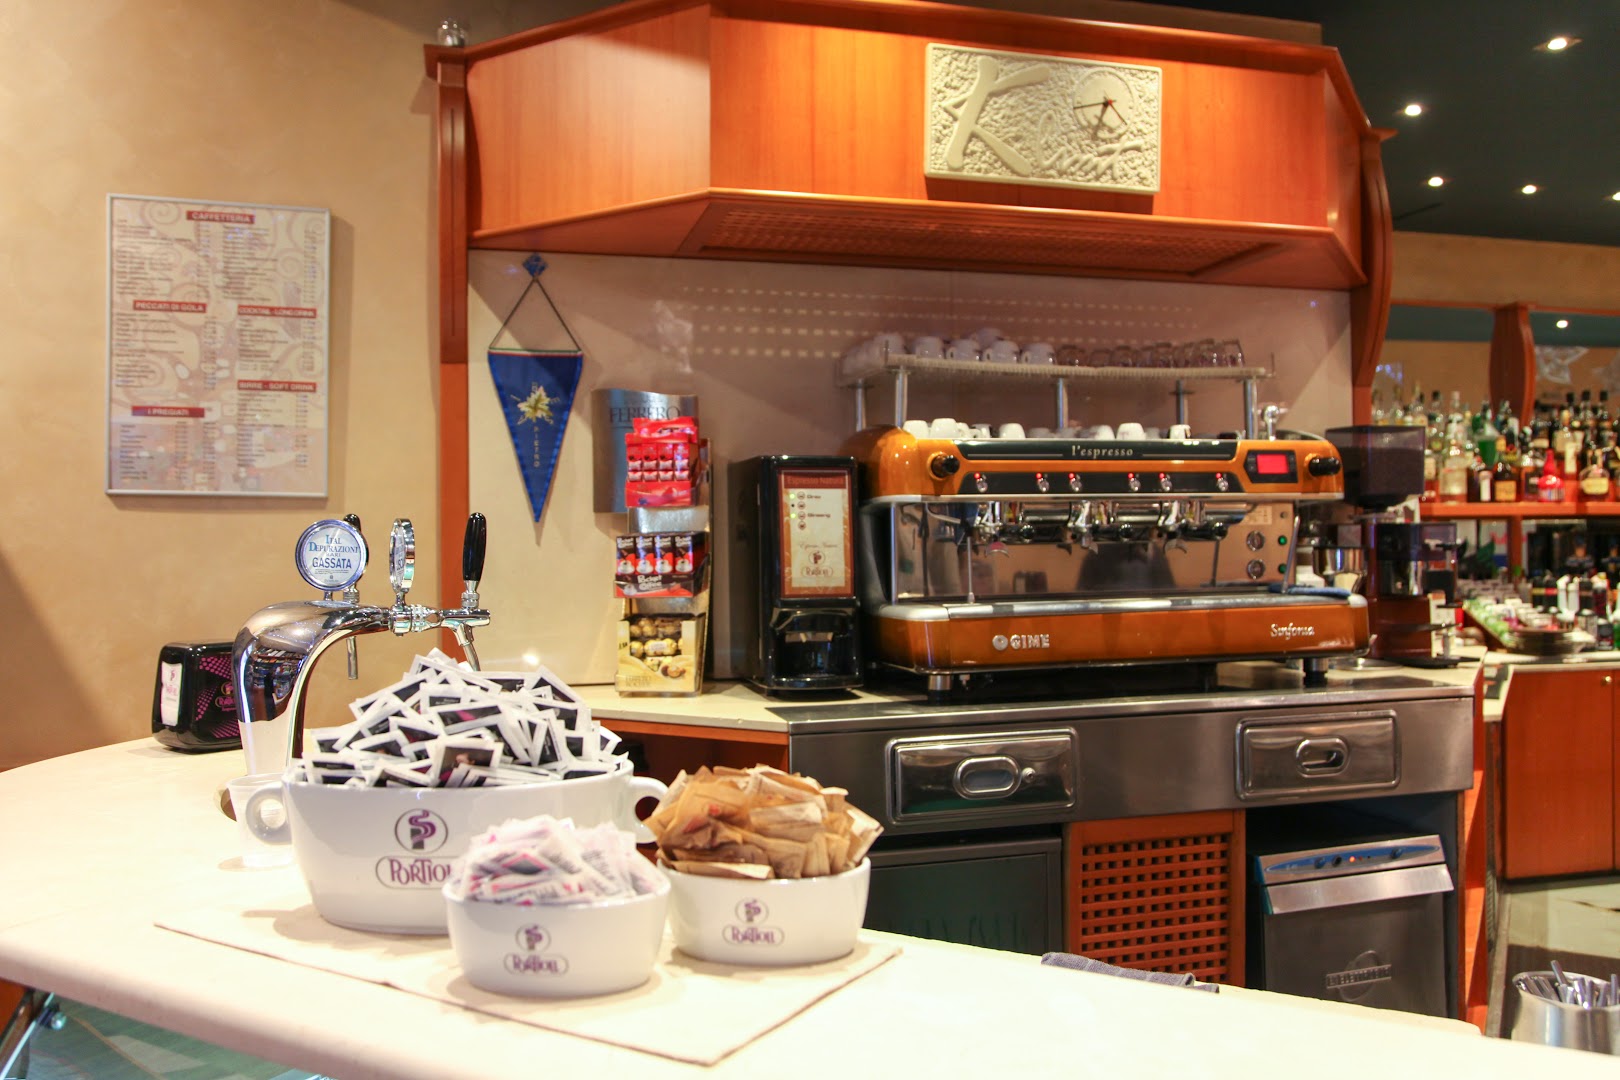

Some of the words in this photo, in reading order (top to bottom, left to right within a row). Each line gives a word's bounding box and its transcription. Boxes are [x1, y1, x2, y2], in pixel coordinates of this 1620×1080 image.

[191, 211, 251, 223] CAFFETTERIA
[135, 301, 170, 311] PECCATI
[180, 303, 204, 312] GOLA
[269, 382, 289, 391] SOFT
[1071, 445, 1134, 460] l'espresso
[312, 557, 352, 569] GASSATA
